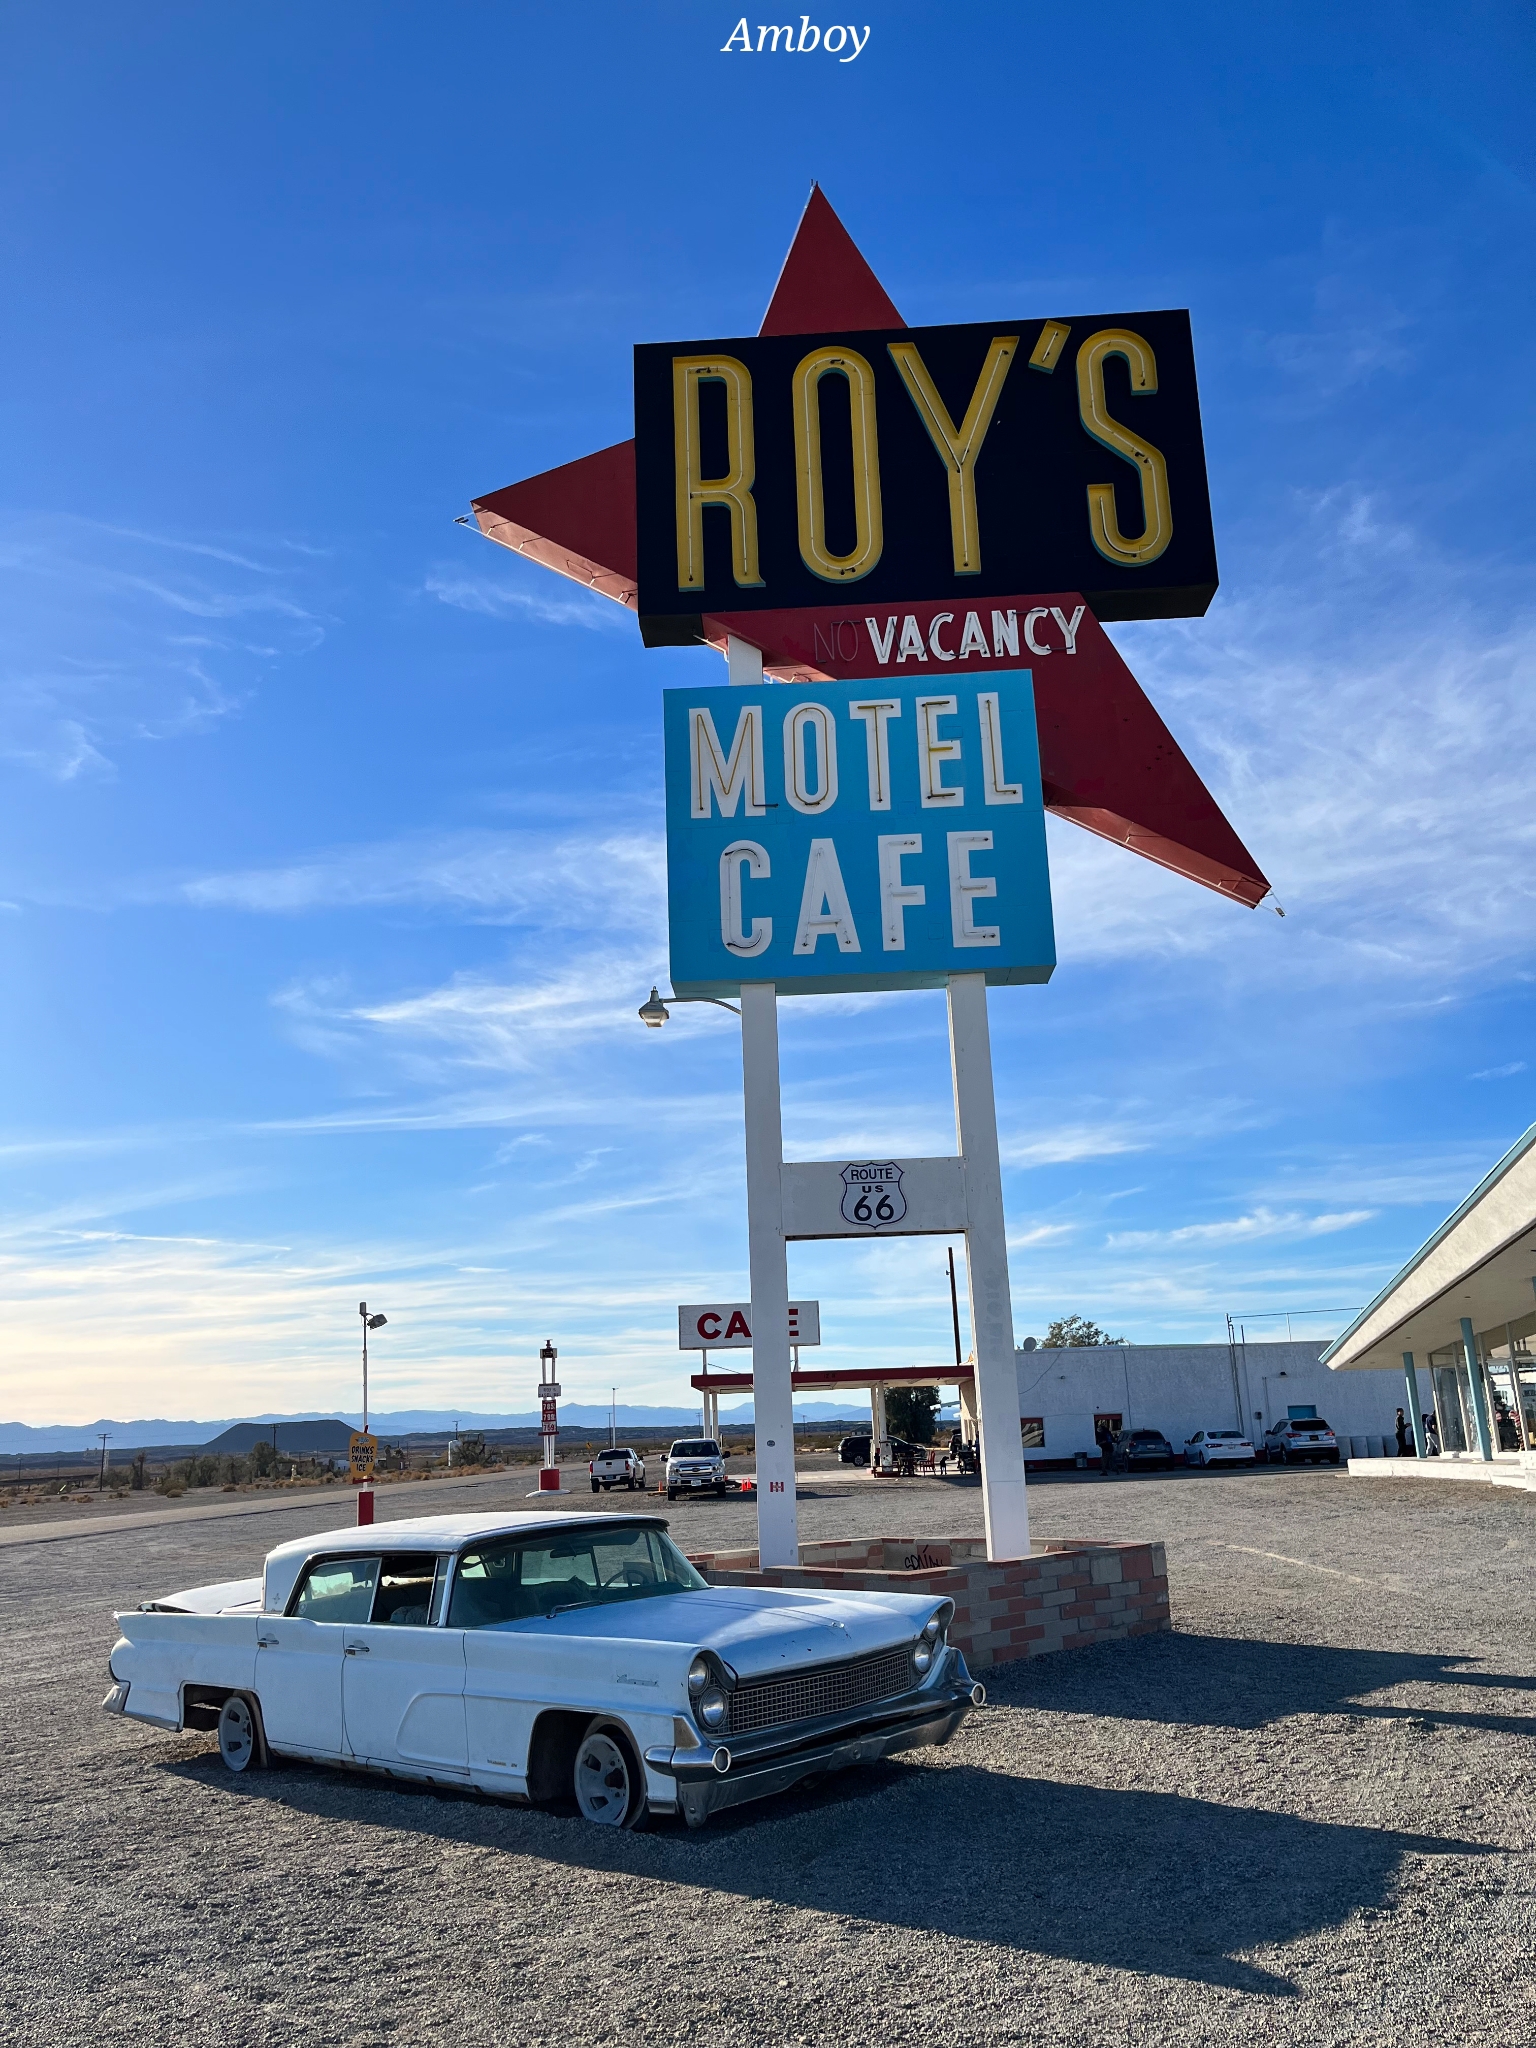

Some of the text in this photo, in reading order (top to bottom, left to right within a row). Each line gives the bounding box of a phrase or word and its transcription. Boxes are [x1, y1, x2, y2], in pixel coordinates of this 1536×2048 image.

[673, 320, 1173, 592] ROY'S
[813, 605, 1086, 664] NO VACANCY
[689, 692, 1024, 819] MOTEL
[719, 830, 1001, 957] CAFE
[850, 1168, 894, 1181] ROUTE
[862, 1185, 884, 1193] US
[853, 1194, 894, 1222] 66
[697, 1310, 799, 1340] CAE
[351, 1446, 374, 1454] DRINKS
[351, 1455, 374, 1463] SNACKS
